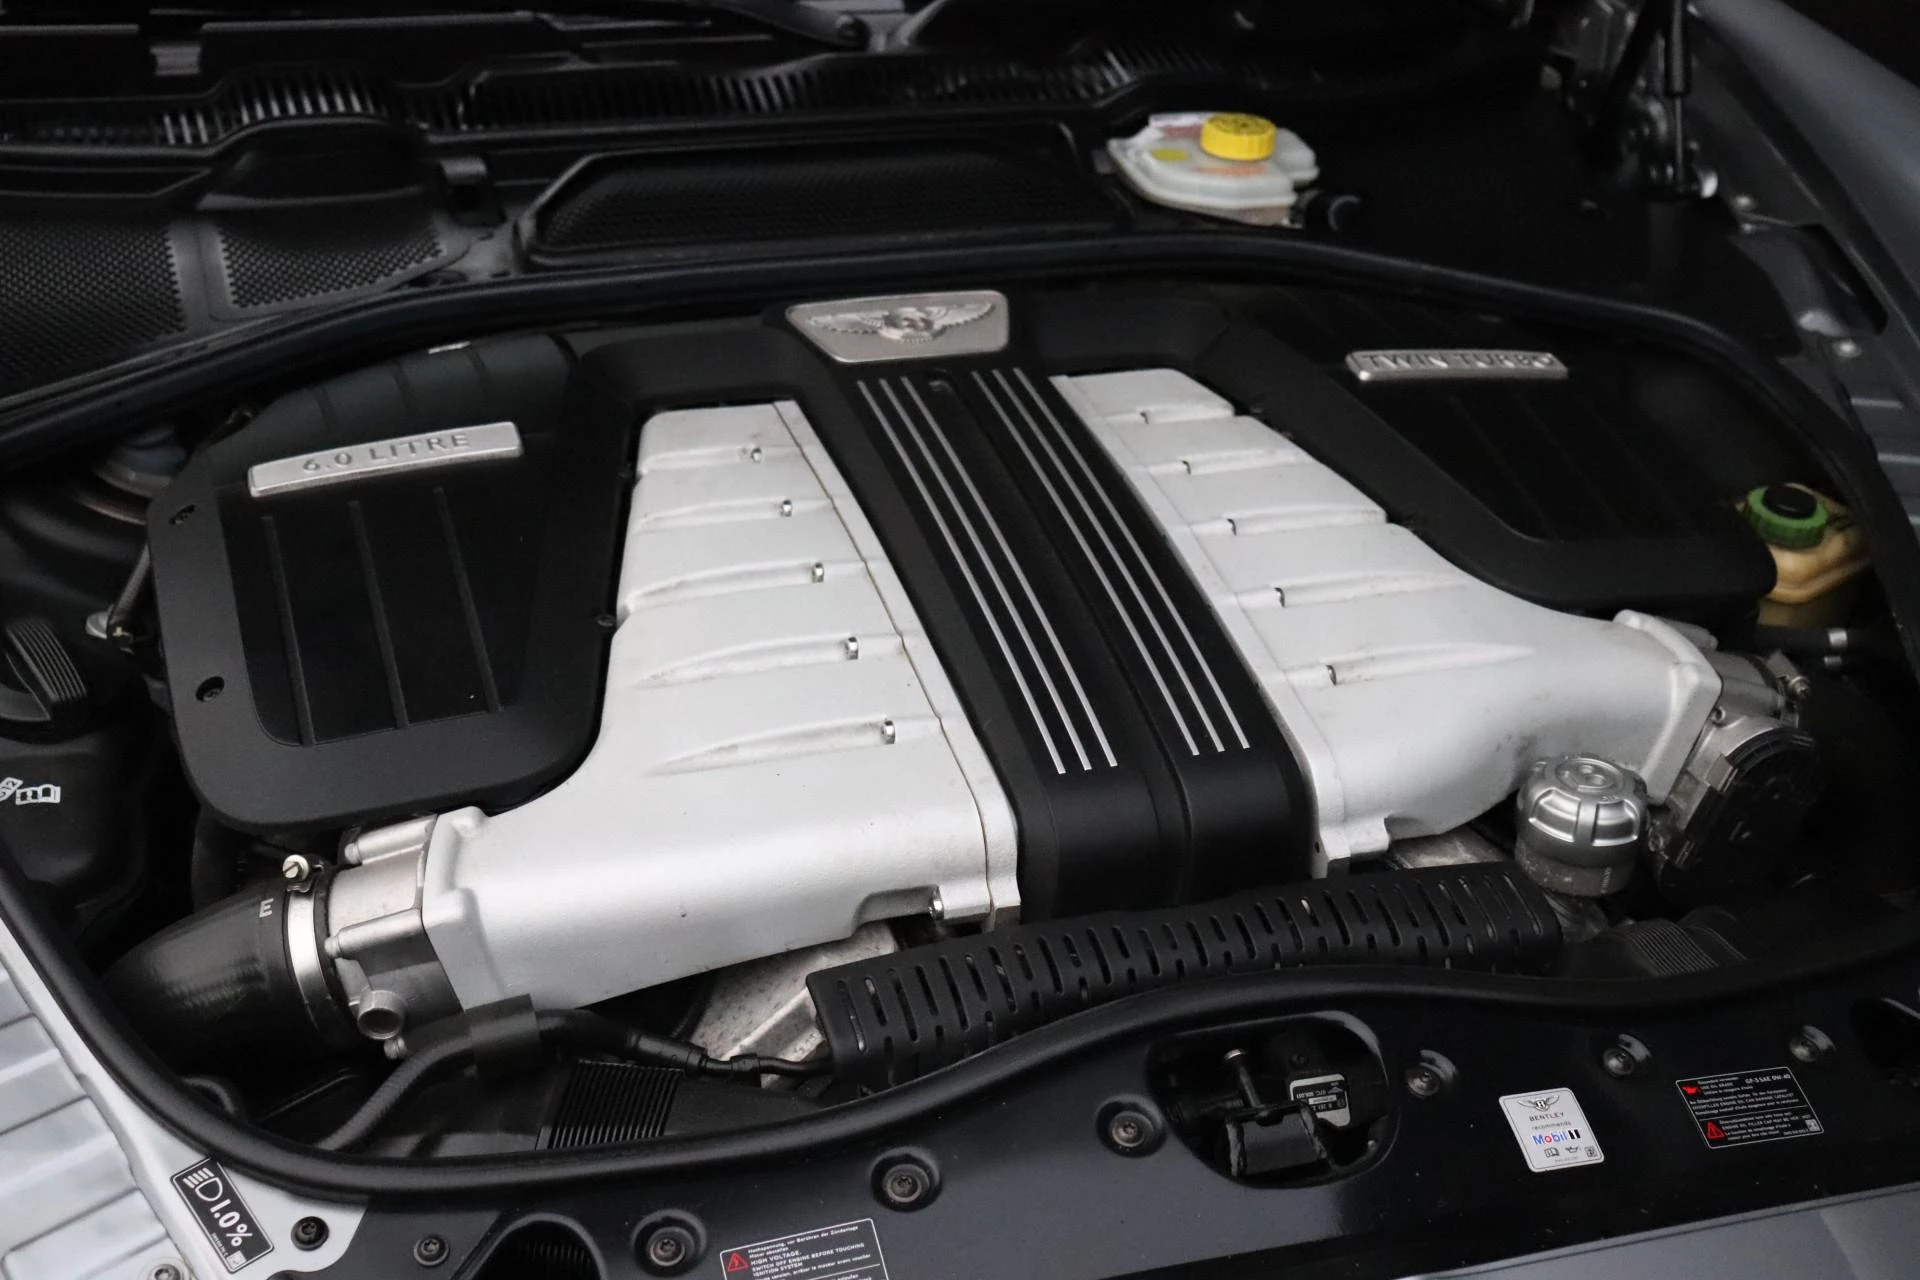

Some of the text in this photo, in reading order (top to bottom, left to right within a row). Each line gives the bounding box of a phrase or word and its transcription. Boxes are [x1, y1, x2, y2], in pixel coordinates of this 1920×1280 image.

[1359, 355, 1449, 369] TWIN
[302, 433, 470, 473] 6.0 LITRE
[259, 898, 274, 918] E
[1529, 1111, 1565, 1122] BENTLEY
[1532, 1120, 1572, 1131] recommends
[1532, 1130, 1568, 1146] Mobil
[210, 1198, 253, 1247] 1.0%
[751, 1258, 768, 1266] HIGH
[752, 1263, 775, 1272] SWITCH
[788, 1254, 810, 1264] ENGINE
[811, 1248, 834, 1259] BEFORE
[835, 1242, 865, 1253] TOUCHING
[753, 1261, 803, 1277] IGNITION SYSTEM
